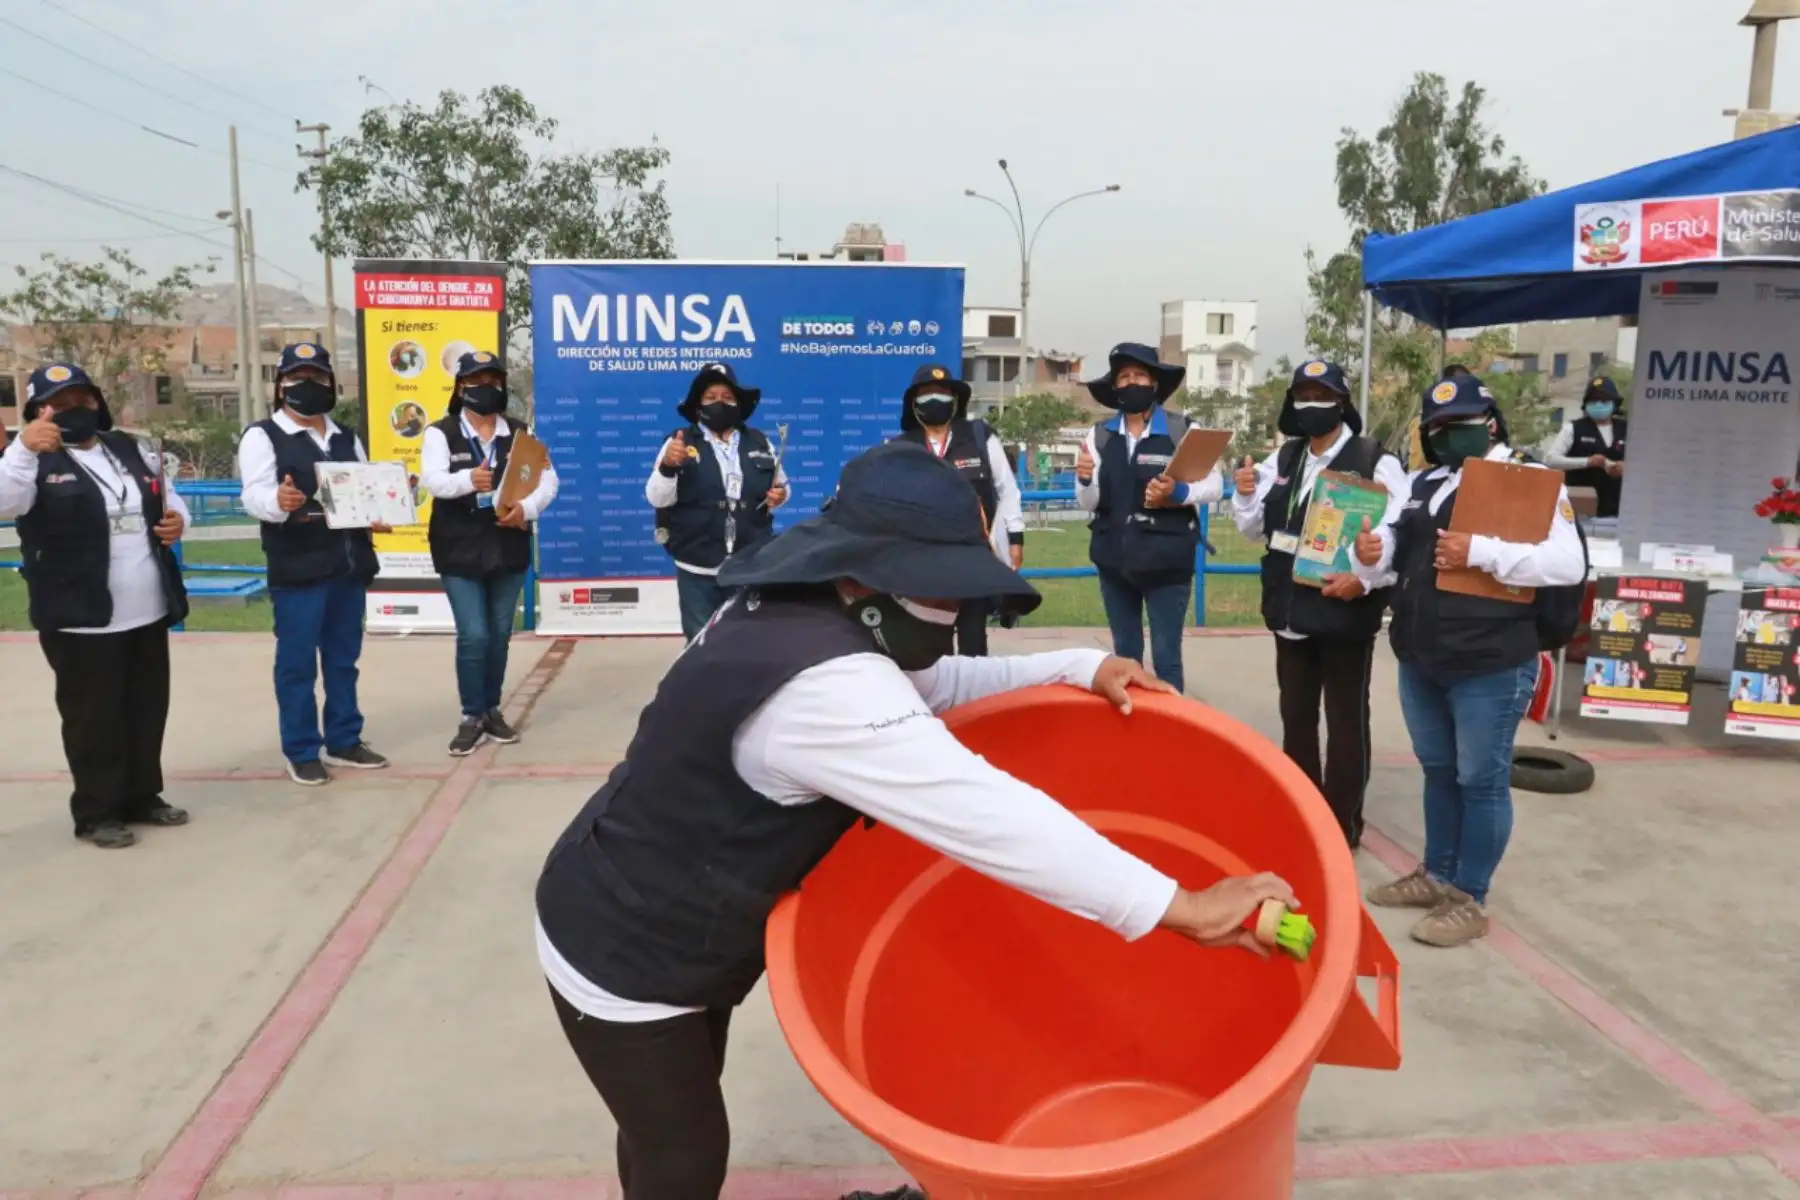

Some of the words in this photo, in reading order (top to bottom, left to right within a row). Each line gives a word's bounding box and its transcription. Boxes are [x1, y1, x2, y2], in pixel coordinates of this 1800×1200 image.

[1649, 216, 1710, 241] PERÚ
[1727, 227, 1754, 242] de
[1760, 224, 1800, 241] Salu
[552, 294, 756, 343] MINSA
[381, 321, 393, 333] Si
[782, 322, 801, 335] DE
[804, 322, 855, 335] TODOS
[557, 345, 621, 358] DIRECCIÓN
[623, 347, 638, 358] DE
[642, 347, 677, 358] REDES
[680, 347, 753, 358] INTEGRADAS
[780, 341, 936, 357] #NoBajemosLaGuardia
[589, 360, 605, 371] DE
[607, 360, 645, 371] SALUD
[648, 360, 677, 371] LIMA
[1648, 351, 1792, 385] MINSA
[1645, 387, 1685, 400] DIRIS
[1690, 389, 1729, 401] LIMA
[1735, 390, 1789, 404] NORTE
